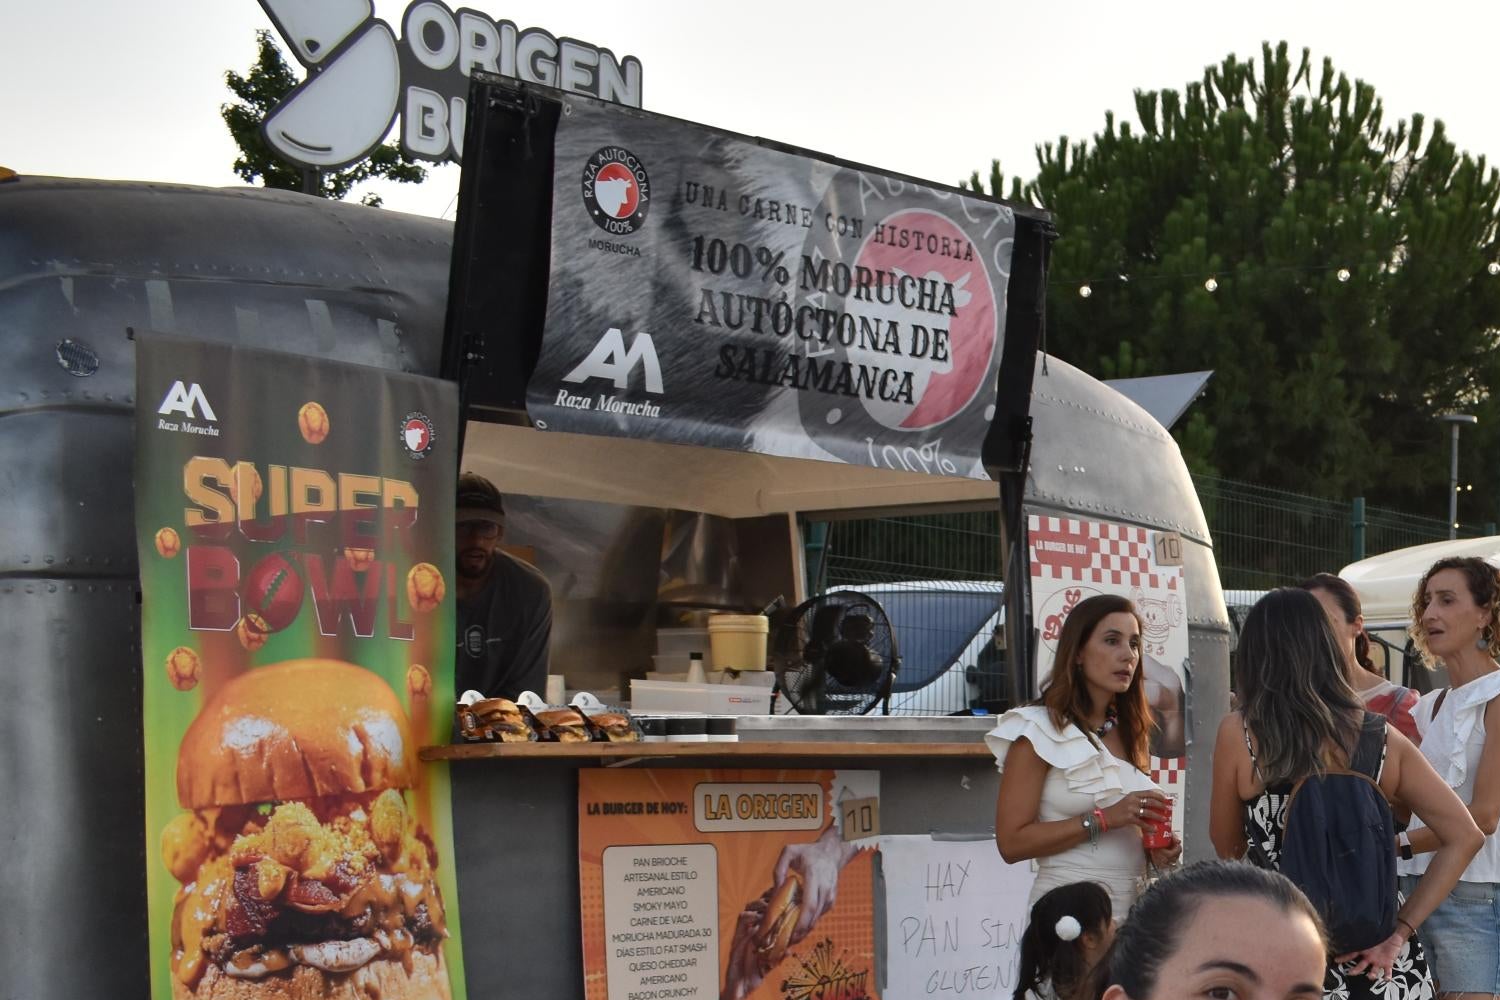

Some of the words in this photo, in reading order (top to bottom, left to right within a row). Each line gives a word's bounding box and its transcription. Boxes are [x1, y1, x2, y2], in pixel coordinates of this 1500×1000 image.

[405, 1, 640, 107] ORIGEN
[584, 163, 598, 198] RAZA
[598, 149, 648, 202] AUTOCTONA
[605, 219, 633, 233] 100%
[685, 181, 728, 211] UNA
[738, 194, 814, 229] CARNE
[825, 212, 863, 239] CON
[873, 223, 974, 262] HISTORIA
[588, 239, 641, 256] MORUCHA
[691, 234, 790, 287] 100%
[800, 255, 959, 318] MORUCHA
[694, 288, 903, 357] AUTÓCTONA
[909, 323, 950, 362] DE
[714, 343, 915, 405] SALAMANCA
[554, 388, 592, 410] Raza
[594, 394, 661, 418] Morucha
[158, 418, 179, 431] Raza
[180, 421, 220, 436] Morucha
[182, 455, 420, 549] SUPER
[1157, 536, 1181, 560] 10
[586, 802, 600, 816] LA
[602, 801, 644, 815] BURGER
[646, 802, 660, 815] DE
[661, 801, 688, 815] HOY:
[704, 794, 733, 820] LA
[736, 793, 818, 820] ORIGEN
[845, 805, 873, 833] 10
[633, 857, 650, 867] PAN
[651, 856, 688, 866] BRIOCHE
[623, 872, 670, 883] ARTESANAL
[670, 870, 698, 881] ESTILO
[925, 859, 972, 901] HAY
[636, 886, 686, 897] AMERICANO
[633, 902, 662, 912] SMOKY
[663, 900, 688, 910] MAYO
[630, 917, 658, 927] CARNE
[658, 916, 671, 926] DE
[670, 914, 694, 925] VACA
[612, 931, 655, 943] MORUCHA
[655, 929, 701, 940] MADURADA
[701, 927, 712, 937] 30
[899, 914, 959, 957] PAN
[981, 918, 1024, 950] SIN
[635, 945, 662, 957] ESTILO
[663, 944, 679, 955] FAT
[678, 942, 708, 953] SMASH
[628, 961, 658, 973] QUESO
[658, 958, 697, 970] CHEDDAR
[639, 973, 688, 986] AMERICANO
[926, 959, 1013, 994] GLUTEN
[657, 986, 699, 999] CRUNCHY
